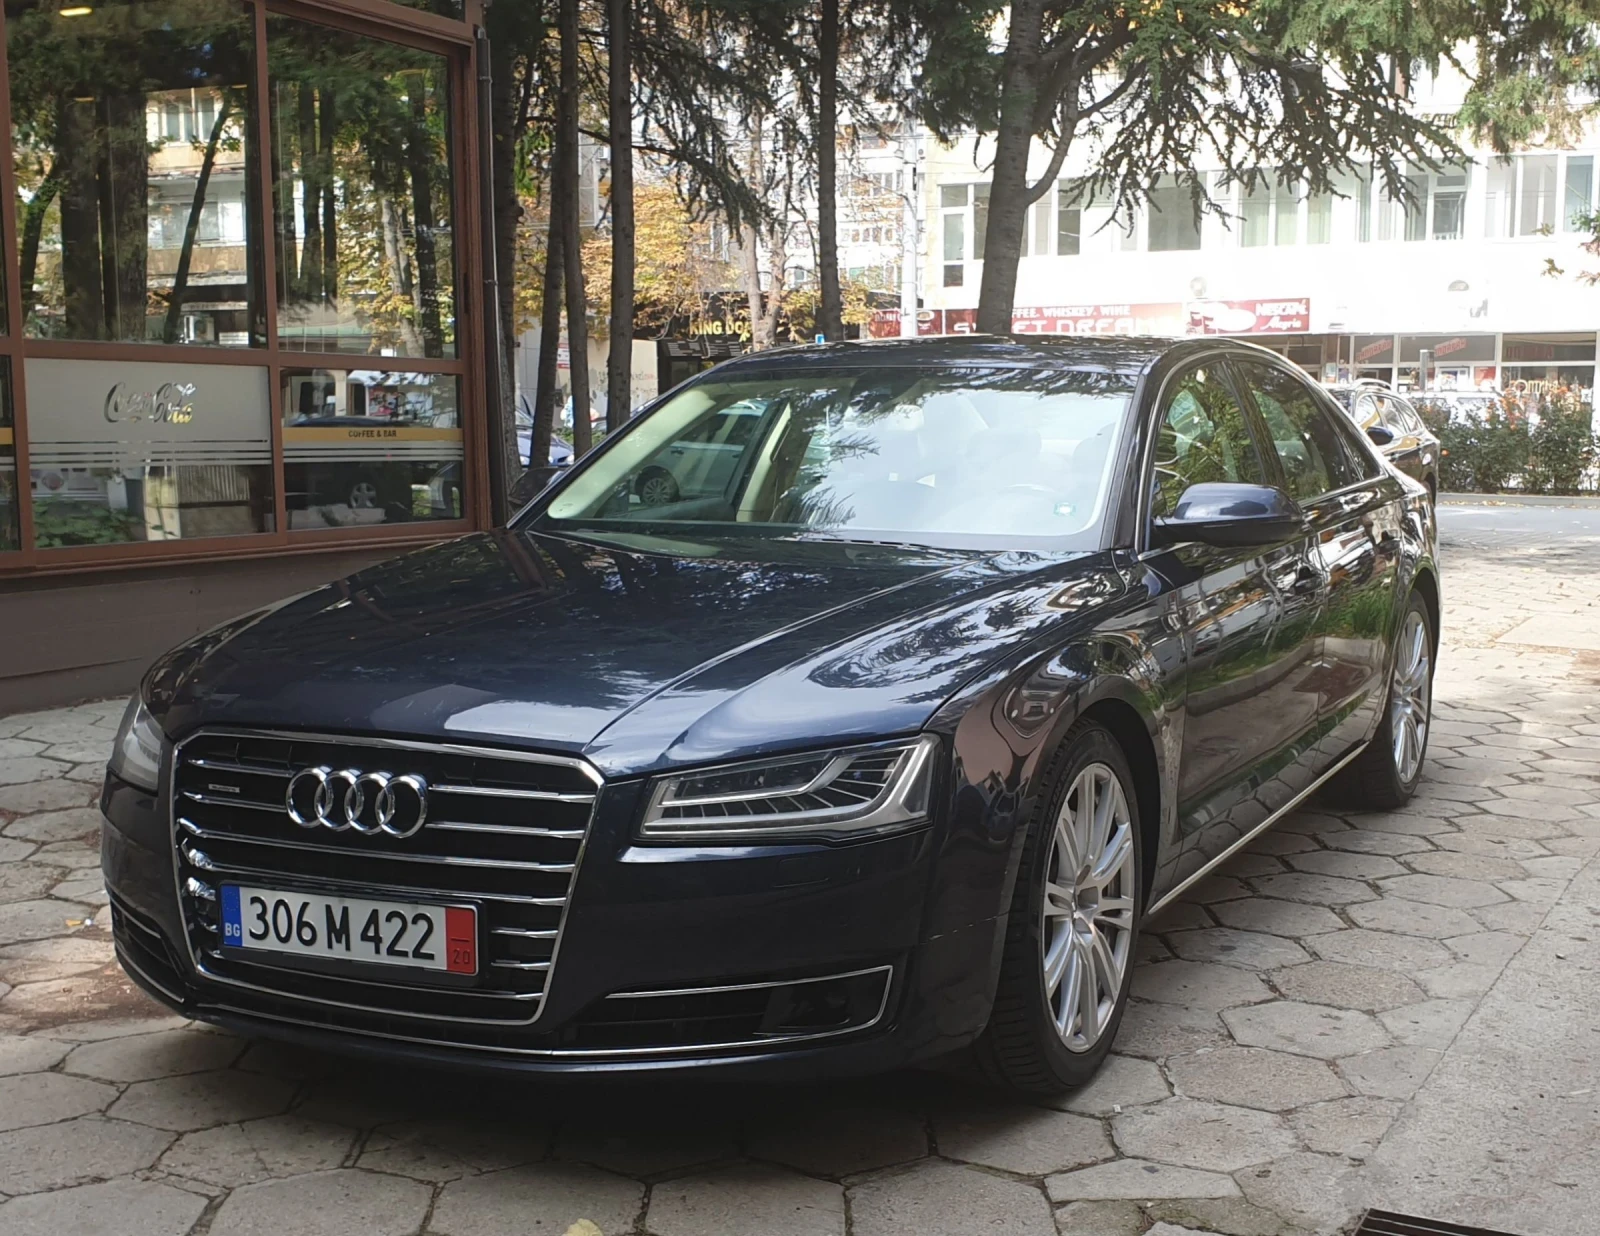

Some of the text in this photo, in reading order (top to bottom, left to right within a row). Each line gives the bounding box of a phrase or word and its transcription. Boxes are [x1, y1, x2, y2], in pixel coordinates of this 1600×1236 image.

[1100, 304, 1131, 316] WINE
[689, 320, 723, 336] KING
[348, 429, 397, 438] COFFEE & BAR
[224, 922, 241, 938] BG
[248, 896, 435, 961] 306 M 422
[453, 949, 471, 965] 20
